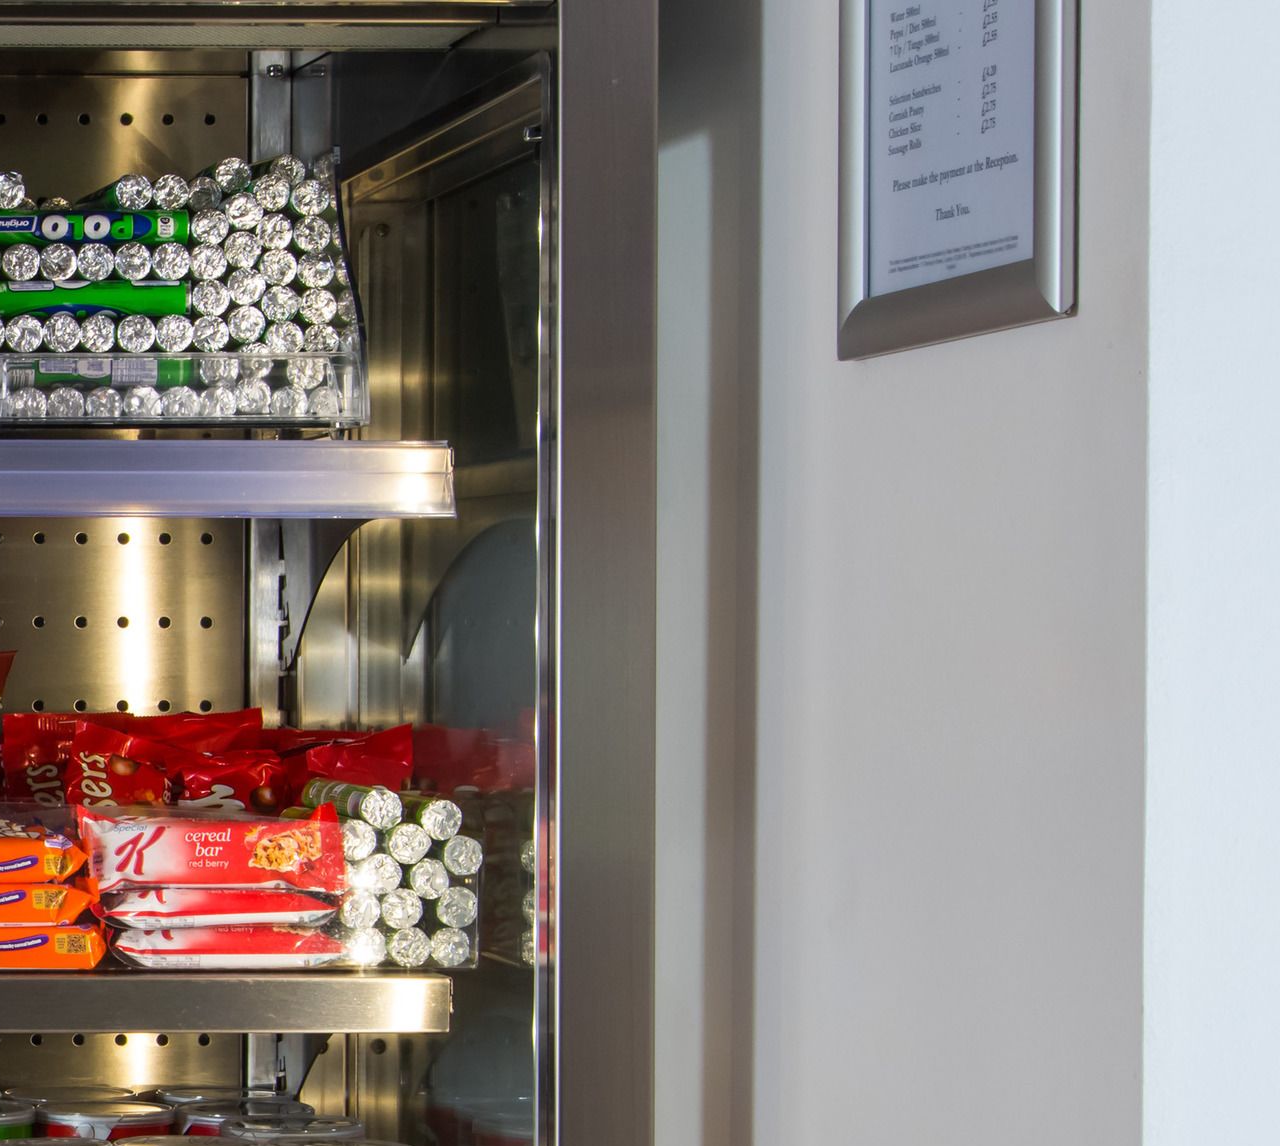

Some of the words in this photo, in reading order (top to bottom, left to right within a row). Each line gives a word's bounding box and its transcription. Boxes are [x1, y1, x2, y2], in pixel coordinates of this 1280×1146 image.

[893, 179, 911, 192] Please
[912, 176, 927, 187] make
[929, 171, 938, 182] the
[939, 167, 966, 184] payment
[966, 164, 973, 173] at
[974, 160, 983, 172] the
[935, 206, 955, 221] Thank
[42, 215, 133, 240] POLO
[184, 829, 231, 843] cereal
[195, 843, 224, 857] bar
[188, 859, 203, 868] red
[205, 859, 229, 869] berry
